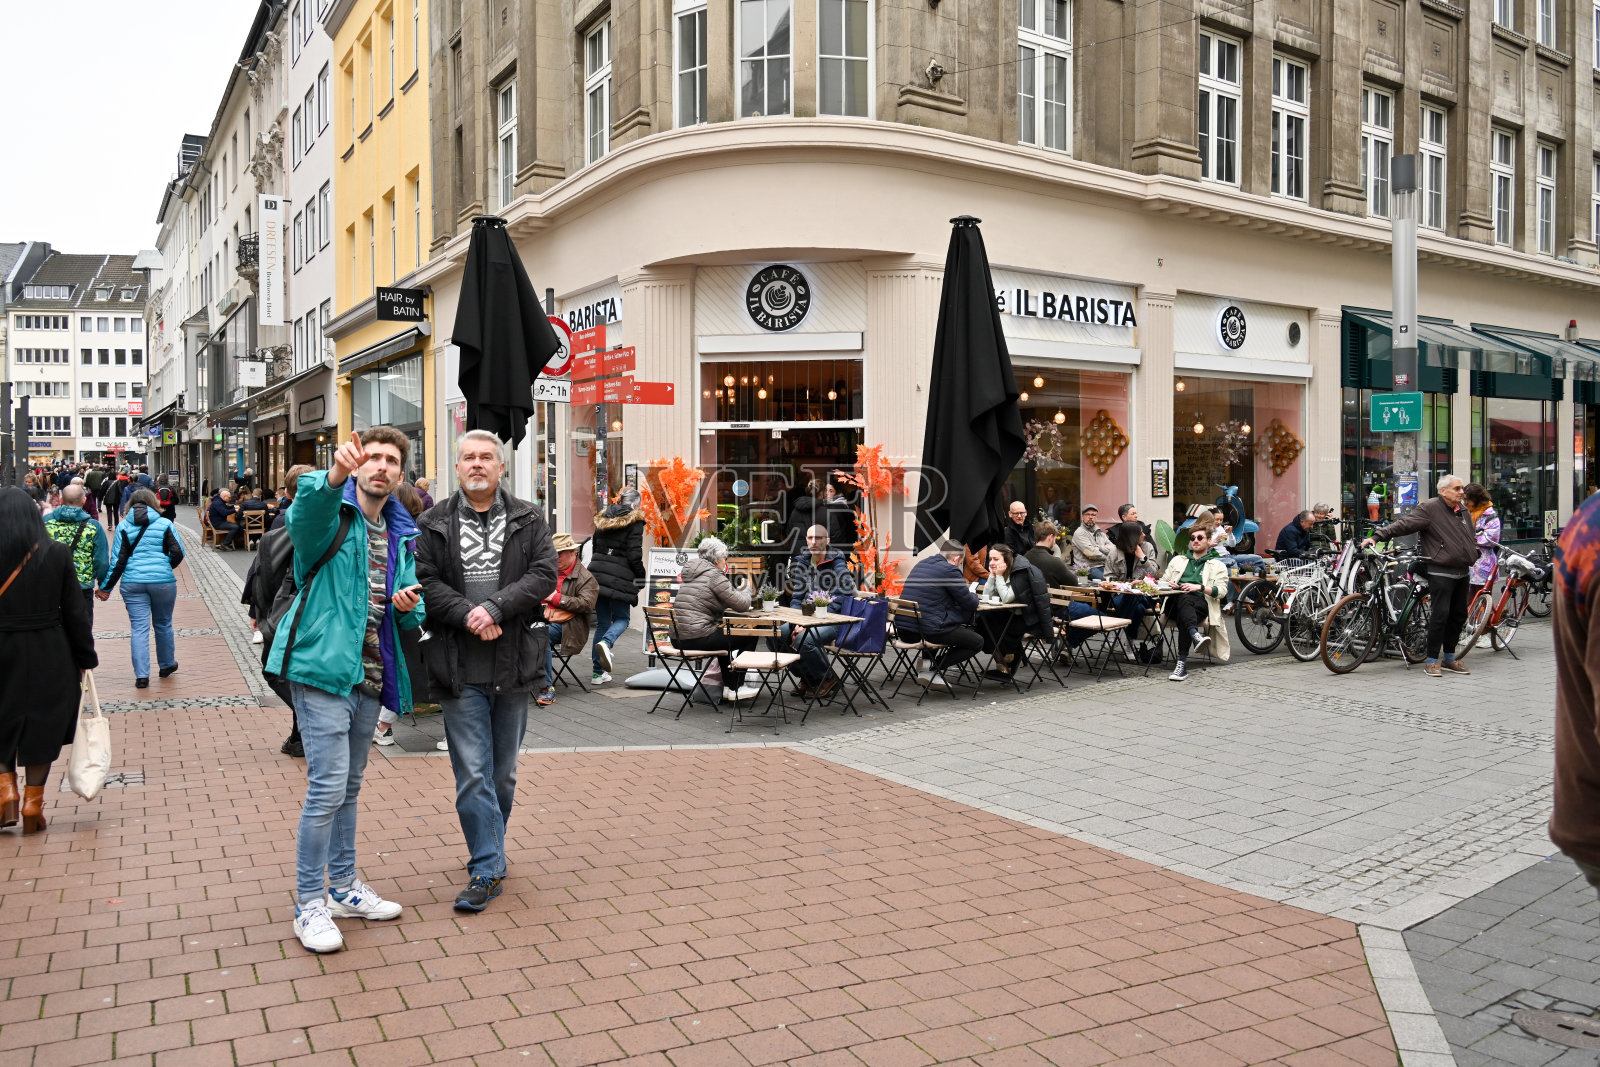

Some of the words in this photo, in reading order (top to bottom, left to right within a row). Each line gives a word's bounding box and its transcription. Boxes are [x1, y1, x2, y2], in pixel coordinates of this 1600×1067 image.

[265, 220, 277, 270] DREESEN
[760, 268, 800, 285] CAFÉ
[380, 292, 403, 303] HAIR
[405, 296, 415, 304] by
[1015, 288, 1037, 317] IL
[1042, 291, 1138, 328] BARISTA
[393, 305, 420, 317] BATIN
[569, 297, 618, 332] BARISTA
[749, 297, 759, 312] IL
[755, 299, 808, 329] BARISTA
[349, 895, 363, 906] N
